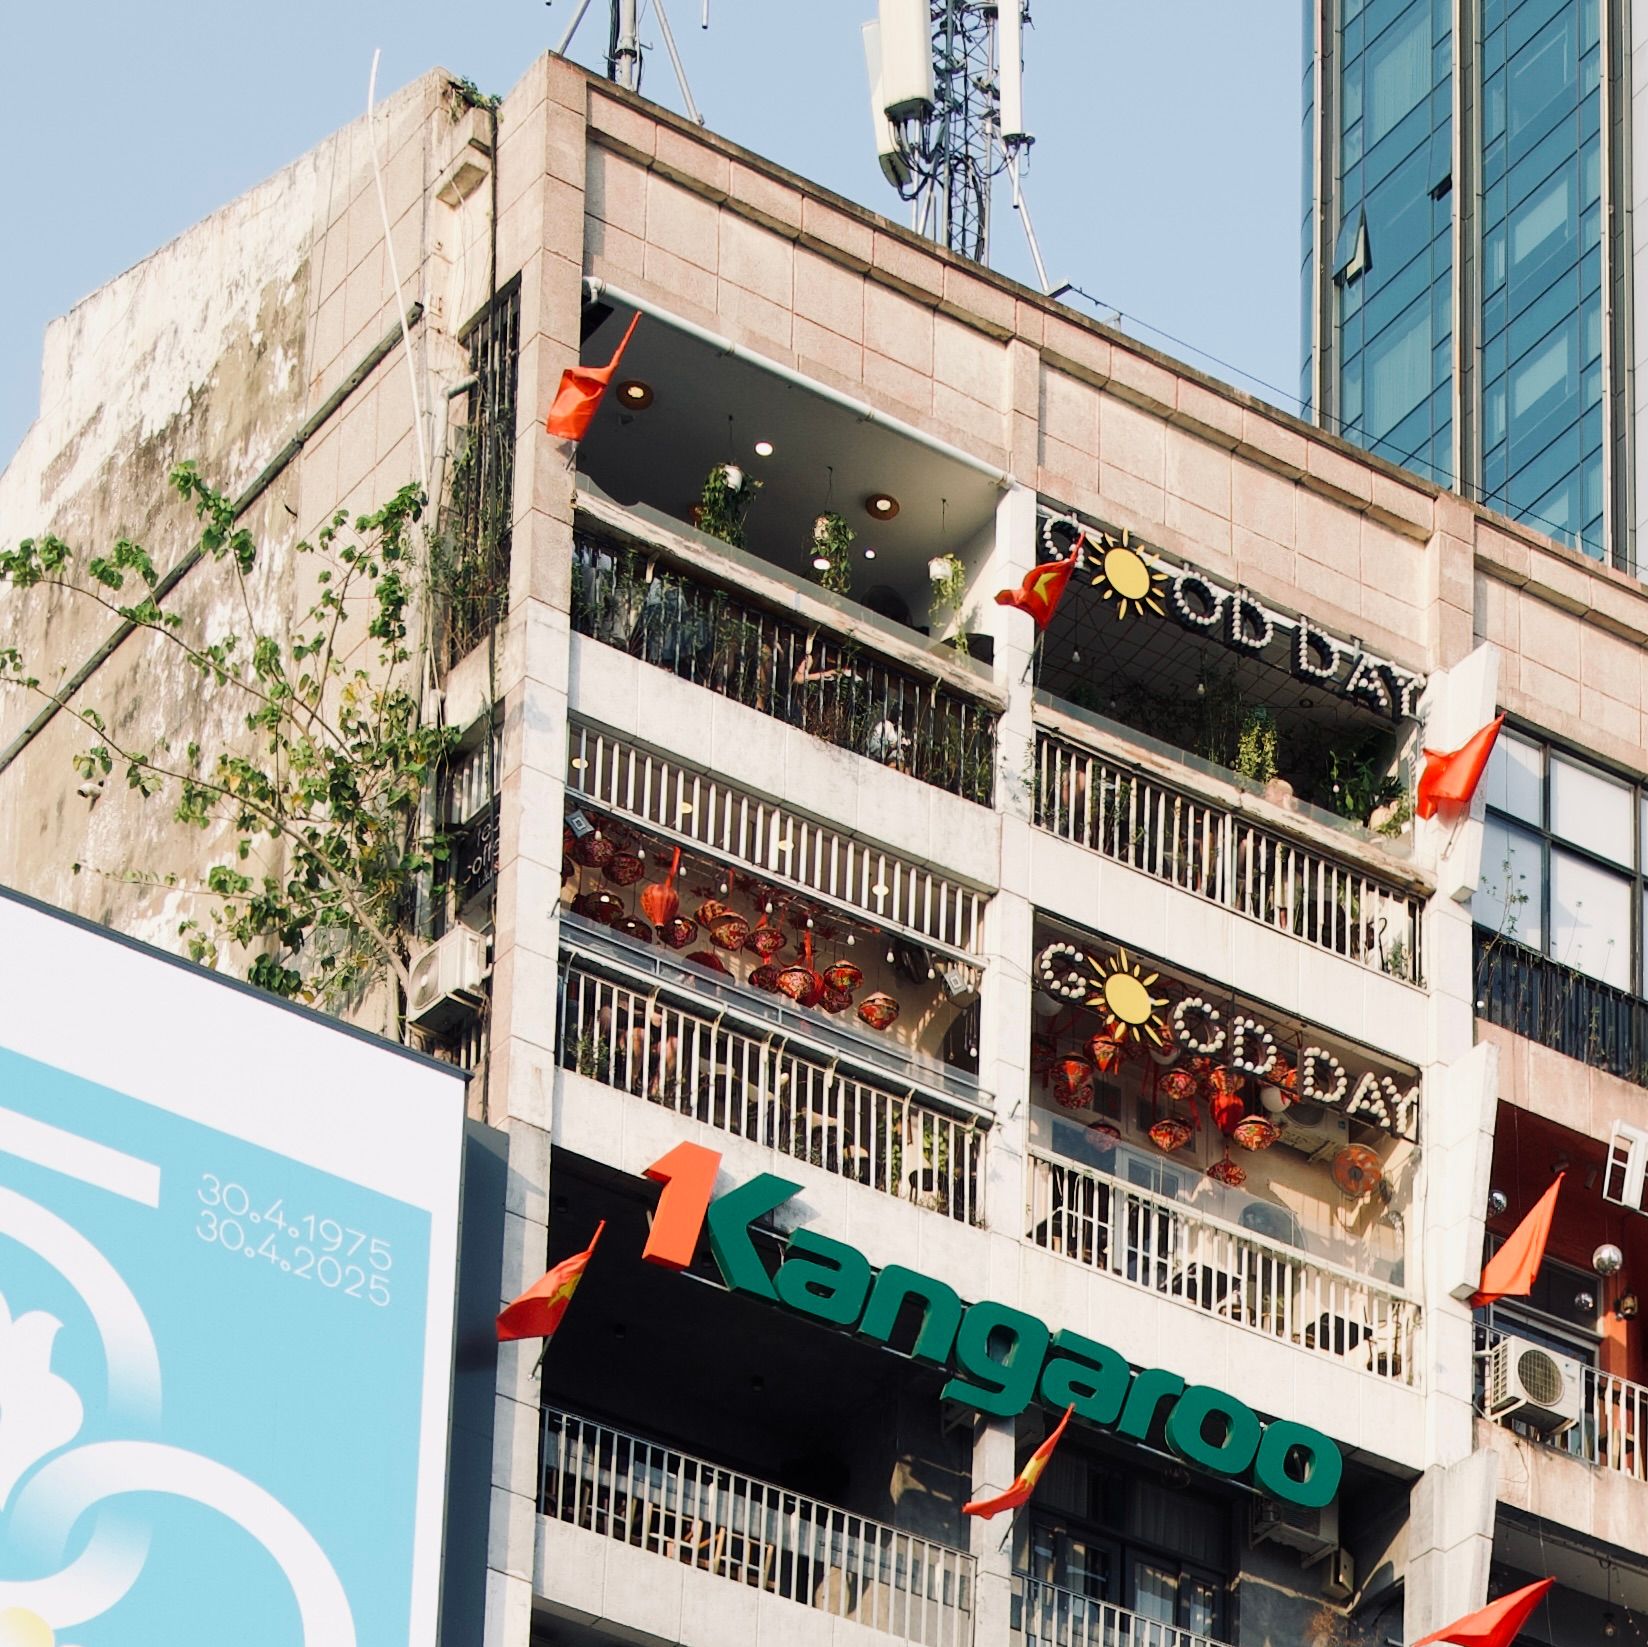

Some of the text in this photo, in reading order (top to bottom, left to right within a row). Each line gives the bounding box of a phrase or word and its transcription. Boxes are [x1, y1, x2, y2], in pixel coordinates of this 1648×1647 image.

[1302, 1045, 1419, 1134] DAY
[195, 1173, 393, 1272] 30.4.1975
[195, 1210, 391, 1307] 30.4.2025
